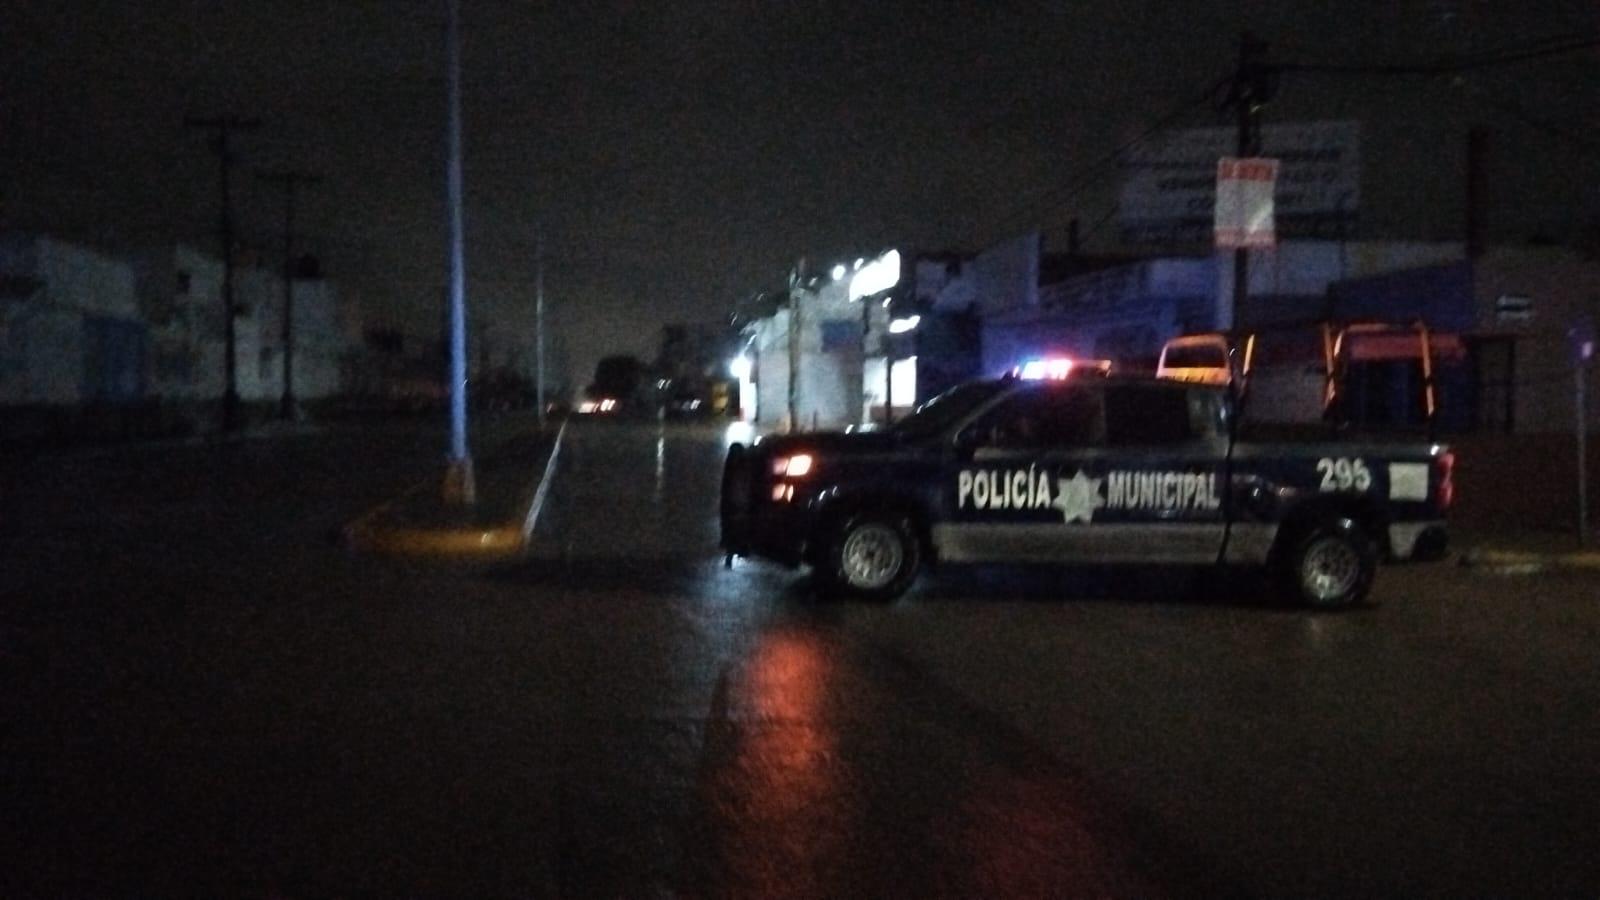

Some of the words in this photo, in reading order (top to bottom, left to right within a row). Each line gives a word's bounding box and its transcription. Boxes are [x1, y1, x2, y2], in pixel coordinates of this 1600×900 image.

[957, 462, 1051, 510] POLICÍA
[1106, 469, 1221, 511] MUNICIPAL
[1316, 457, 1372, 493] 295
